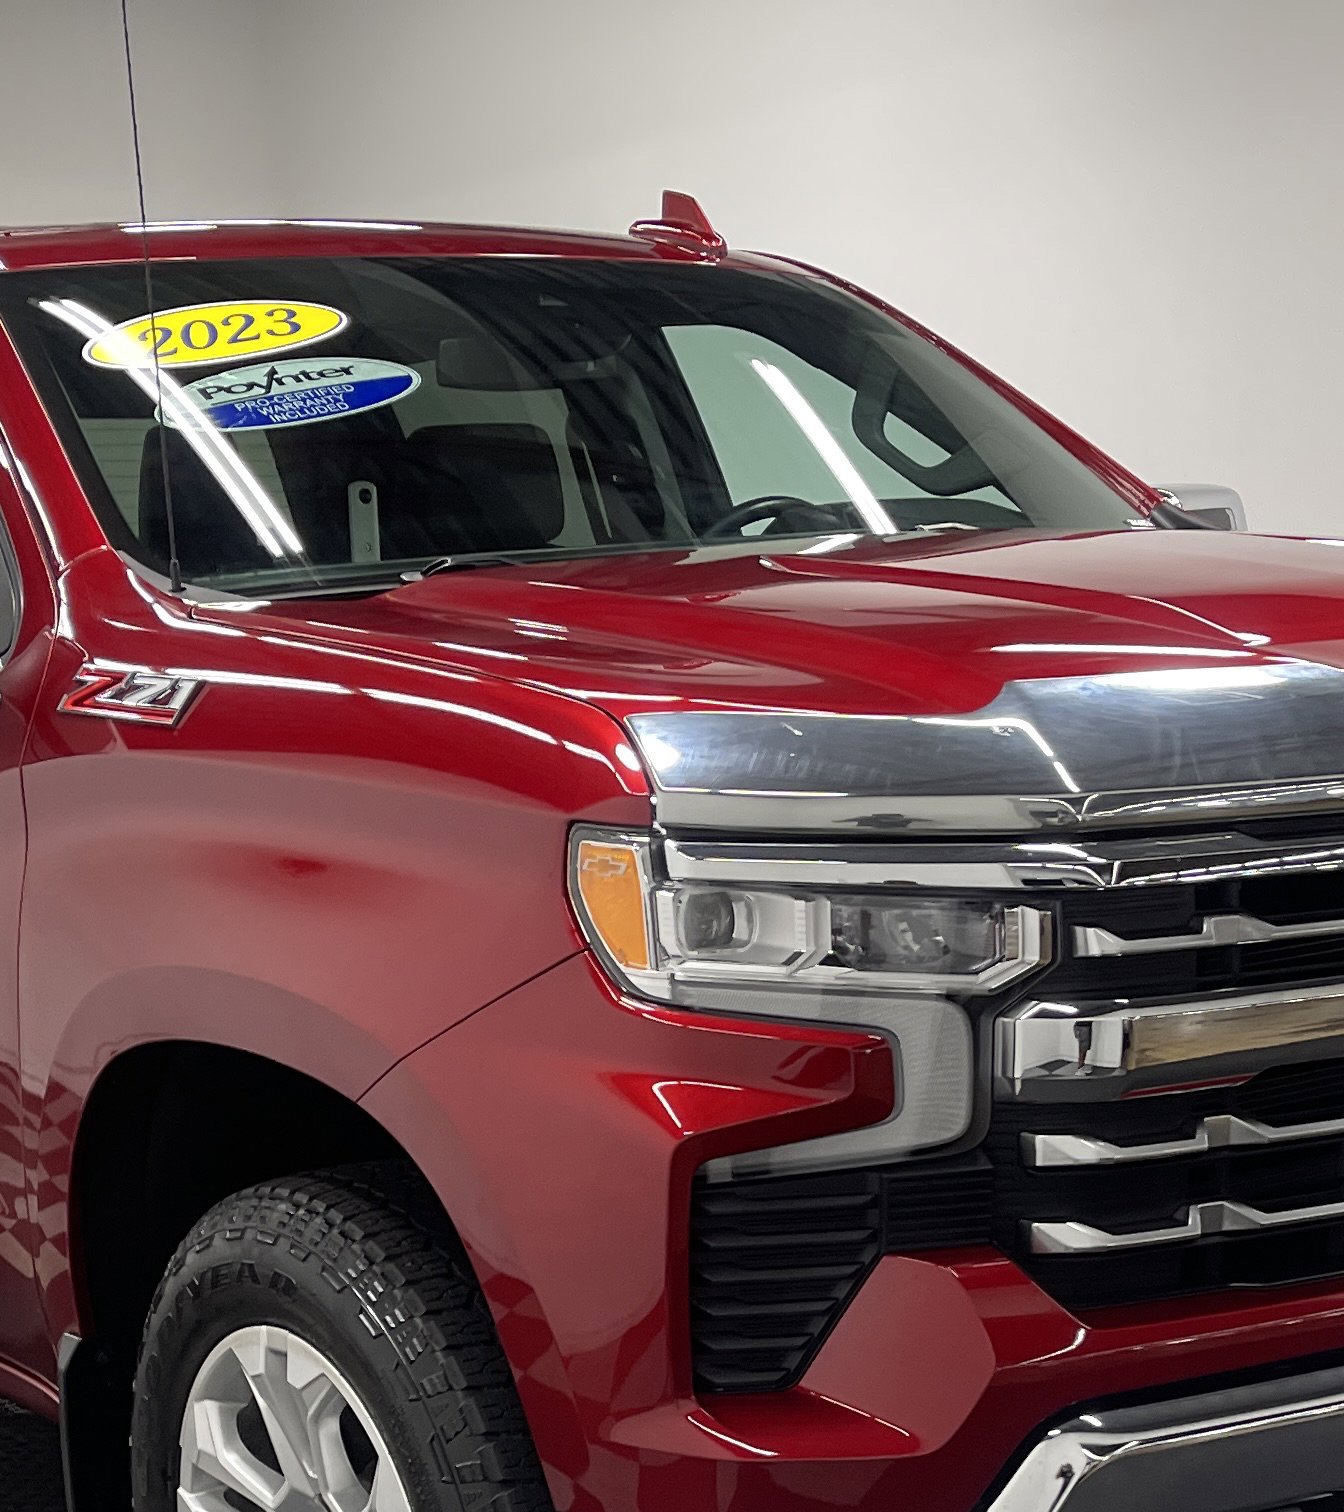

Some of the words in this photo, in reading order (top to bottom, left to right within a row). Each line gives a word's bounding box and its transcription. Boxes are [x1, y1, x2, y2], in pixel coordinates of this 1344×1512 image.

[139, 308, 302, 359] 2023
[197, 365, 355, 400] Poynter
[234, 384, 355, 412] PRO-CERTIFIED
[256, 394, 346, 415] WARRANTY
[269, 402, 350, 424] INCLUDED
[57, 662, 203, 726] Z71
